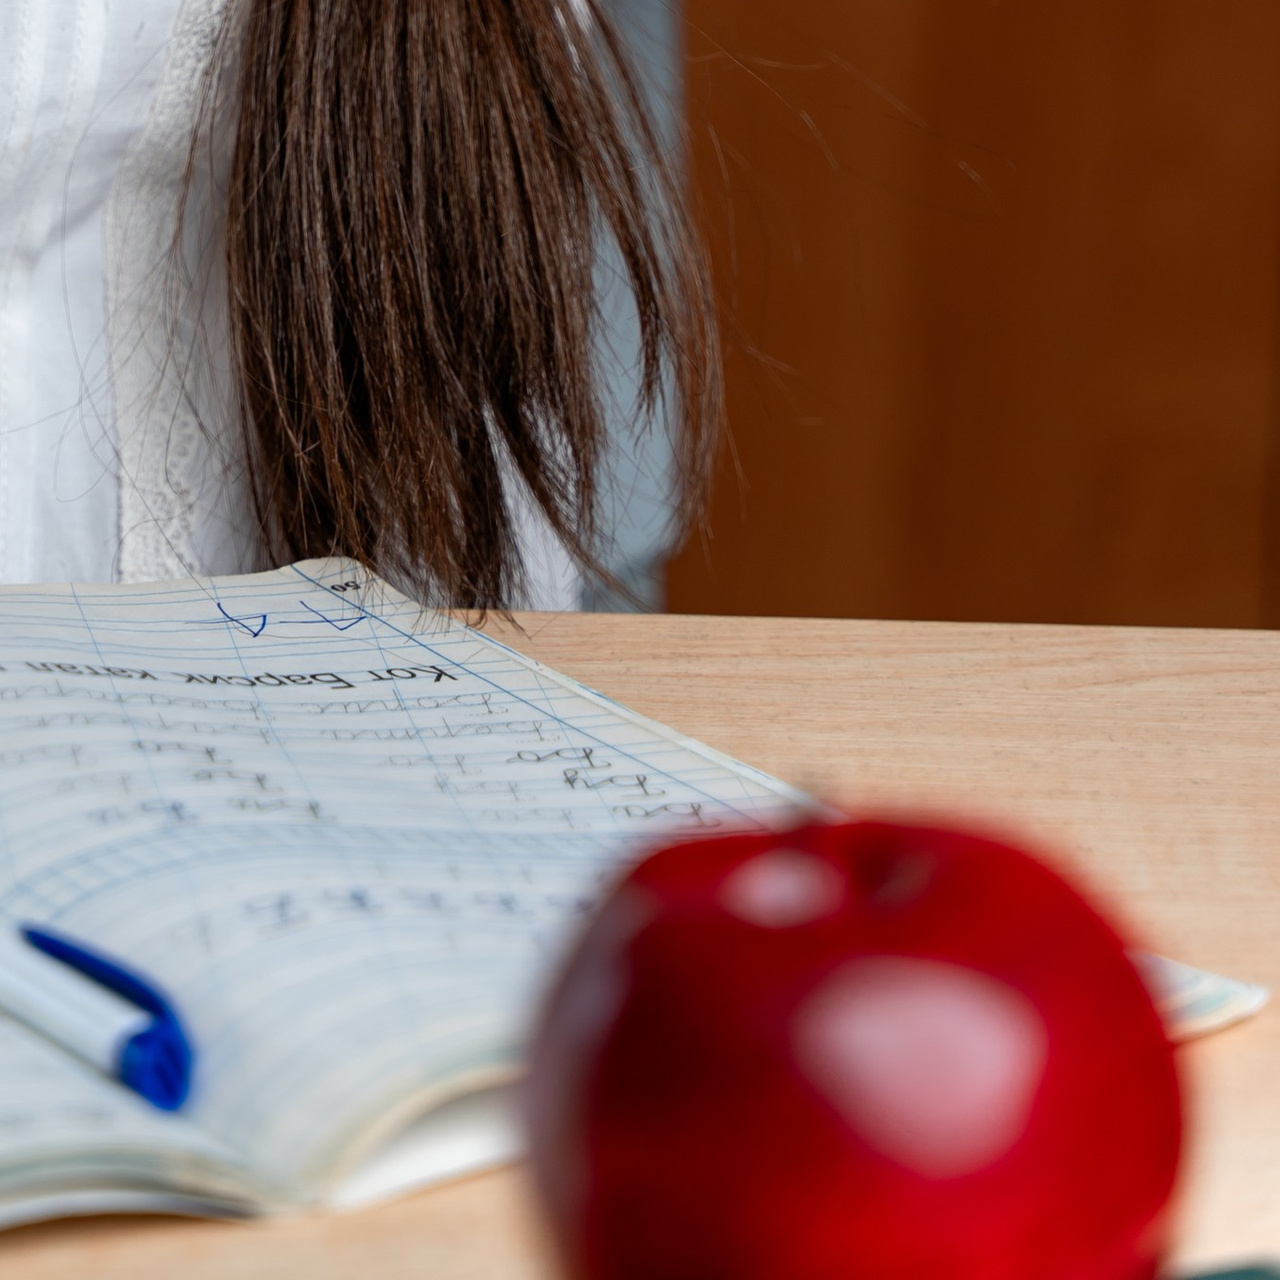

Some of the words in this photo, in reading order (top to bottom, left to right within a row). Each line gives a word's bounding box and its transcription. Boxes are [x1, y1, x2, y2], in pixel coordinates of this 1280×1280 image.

[329, 579, 362, 593] 50
[24, 661, 159, 681] катал
[365, 665, 458, 683] Кот
[171, 671, 356, 691] Барсик
